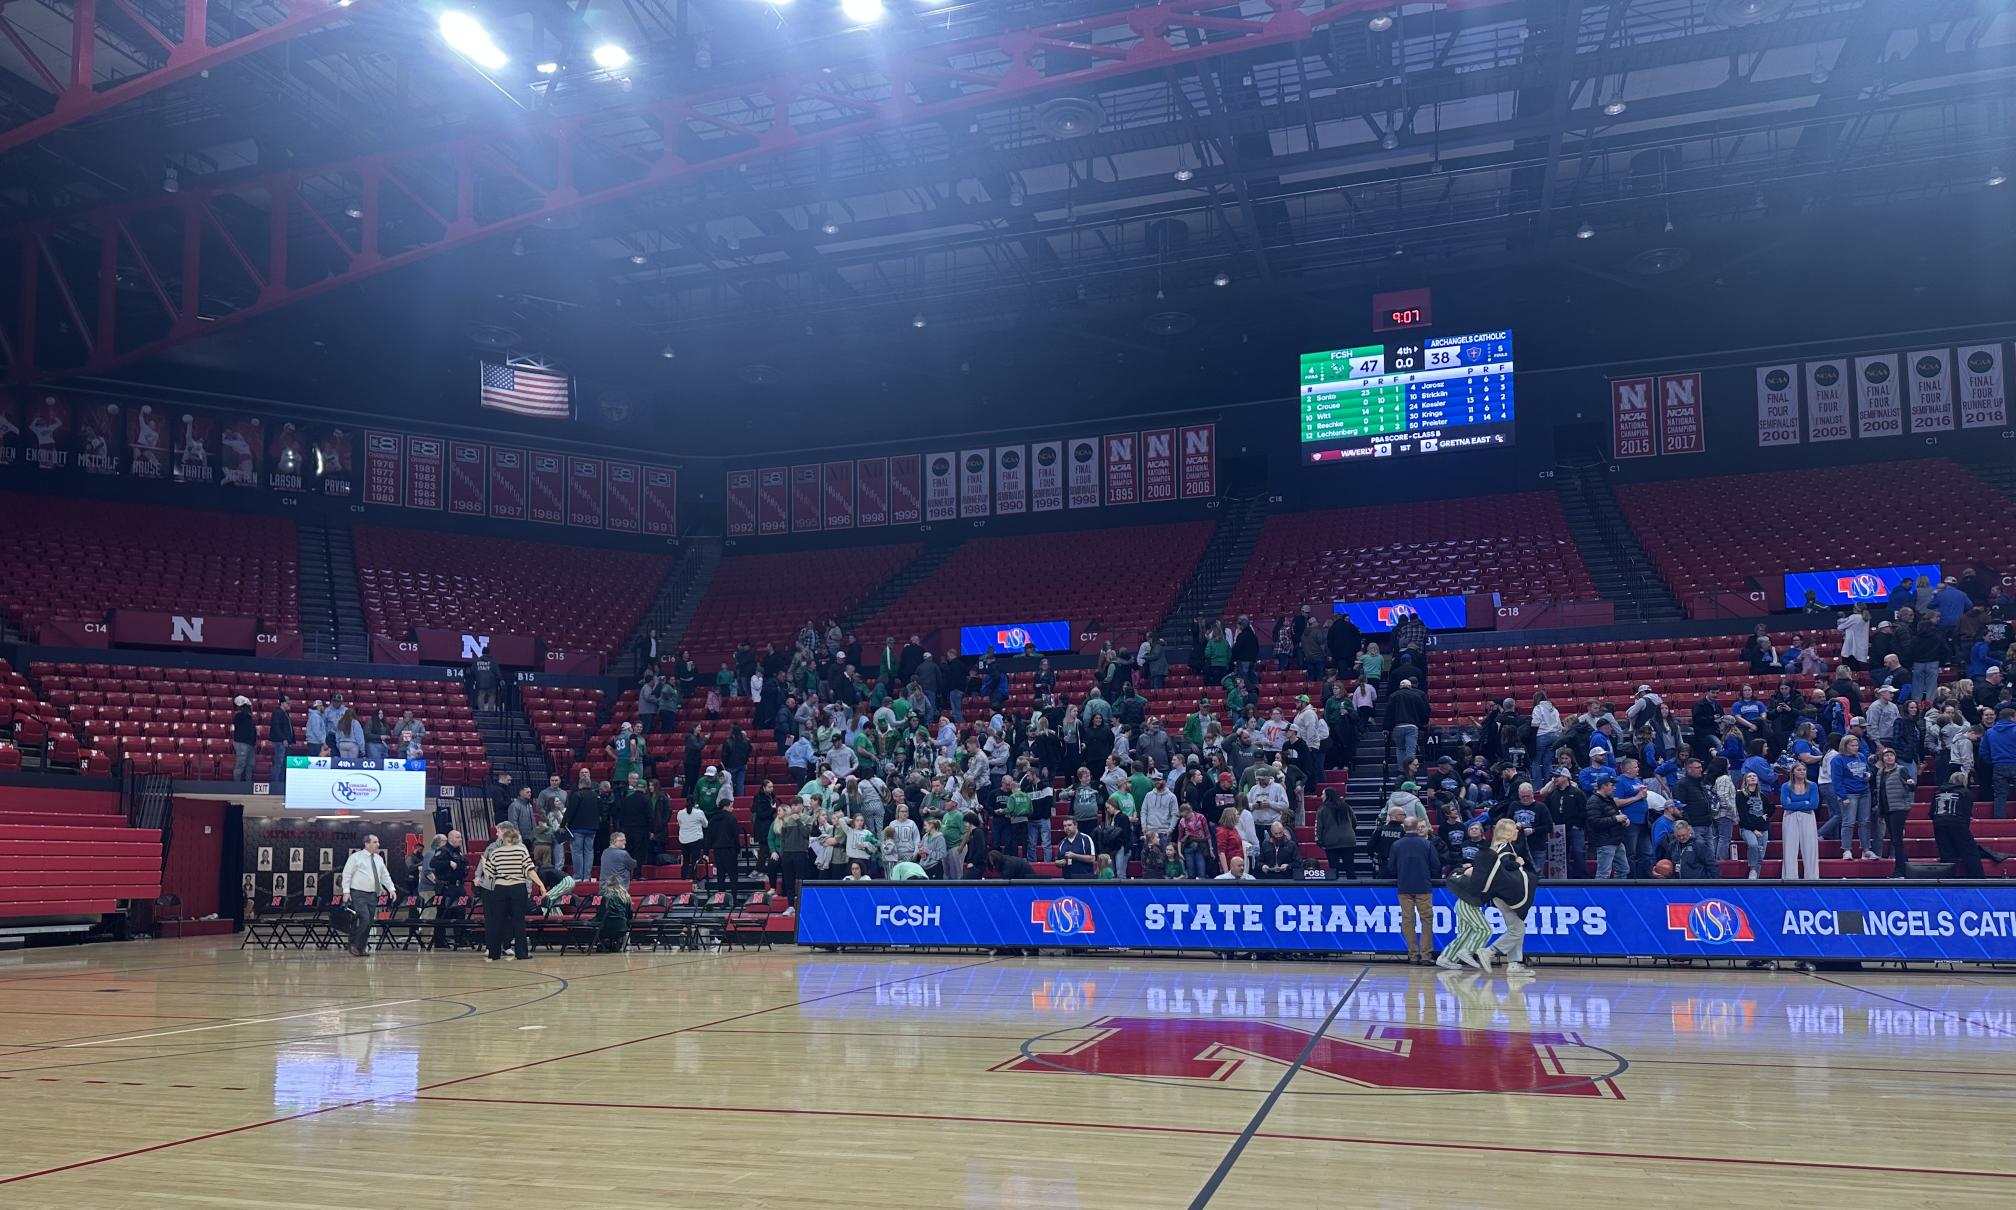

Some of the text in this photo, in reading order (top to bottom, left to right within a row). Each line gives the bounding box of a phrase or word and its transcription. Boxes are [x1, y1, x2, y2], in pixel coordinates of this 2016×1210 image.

[1392, 310, 1419, 323] 9:07
[1430, 332, 1506, 347] ARCHANGELS CATHOLIC
[1330, 350, 1352, 359] FCSH
[1397, 347, 1412, 355] 4th
[1396, 358, 1413, 368] 0.0
[1432, 352, 1450, 364] 38
[1360, 360, 1378, 372] 47
[1919, 380, 1942, 392] FINAL
[1970, 376, 1994, 387] FINAL
[1666, 379, 1695, 406] N
[1817, 390, 1839, 400] FINAL
[1867, 385, 1890, 397] FINAL
[1972, 388, 1992, 398] FOUR
[1619, 384, 1647, 410] N
[1767, 392, 1789, 403] FINAL
[1870, 397, 1890, 408] FOUR
[1921, 393, 1941, 404] FOUR
[1819, 402, 1838, 413] FOUR
[1912, 403, 1952, 415] SEMIFINALIST
[1963, 398, 2004, 410] RUNNER UP
[1667, 408, 1694, 417] NCAA
[1768, 406, 1788, 416] FOUR
[1859, 408, 1900, 420] SEMIFINALIST
[1620, 413, 1646, 421] NCAA
[1667, 417, 1696, 425] NATIONAL
[1816, 415, 1842, 425] FINALIST
[1914, 416, 1950, 428] 2016
[1965, 411, 2003, 423] 2018
[1620, 421, 1648, 430] NATIONAL
[1759, 417, 1798, 429] SEMIFINALIST
[1863, 420, 1898, 432] 2008
[1620, 429, 1648, 438] CHAMPION
[1667, 425, 1696, 433] CHAMPION
[1812, 426, 1847, 438] 2005
[1386, 434, 1408, 442] SCORE
[1762, 430, 1797, 441] 2001
[1148, 434, 1170, 458] N
[1186, 430, 1208, 454] N
[1440, 438, 1471, 447] GRETNA
[1472, 436, 1490, 444] EAST
[1621, 439, 1649, 454] 2015
[1668, 435, 1696, 449] 2017
[1110, 438, 1132, 462] N
[1341, 448, 1373, 457] WAVERLY
[1186, 456, 1208, 464] NCAA
[270, 473, 302, 488] LARSON
[1148, 484, 1171, 498] 2000
[1186, 481, 1210, 495] 2006
[1072, 495, 1096, 504] 1998
[1110, 488, 1133, 501] 1995
[454, 500, 481, 511] 1986
[1000, 502, 1023, 511] 1990
[1035, 498, 1060, 508] 1996
[494, 505, 522, 516] 1987
[533, 508, 560, 521] 1988
[894, 510, 918, 520] 1999
[929, 508, 954, 518] 1986
[964, 505, 987, 514] 1989
[572, 513, 599, 525] 1989
[827, 515, 850, 526] 1996
[862, 512, 885, 523] 1998
[610, 518, 636, 529] 1990
[648, 521, 673, 533] 1991
[730, 523, 753, 533] 1992
[762, 521, 785, 530] 1994
[1750, 592, 1765, 601] C1
[1498, 607, 1519, 616] C18
[85, 623, 107, 632] C14
[171, 615, 204, 642] N
[257, 634, 277, 643] C14
[1080, 633, 1097, 641] C17
[399, 643, 418, 651] C15
[461, 634, 489, 659] N
[547, 652, 564, 660] C15
[446, 668, 464, 677] B14
[518, 672, 534, 681] B15
[615, 739, 626, 750] 33
[255, 784, 268, 793] EXIT
[442, 787, 454, 796] EXIT
[1380, 830, 1401, 838] POLICE
[876, 905, 940, 926] FCSH
[1145, 904, 1262, 932] STATE
[986, 1016, 1627, 1100] N
